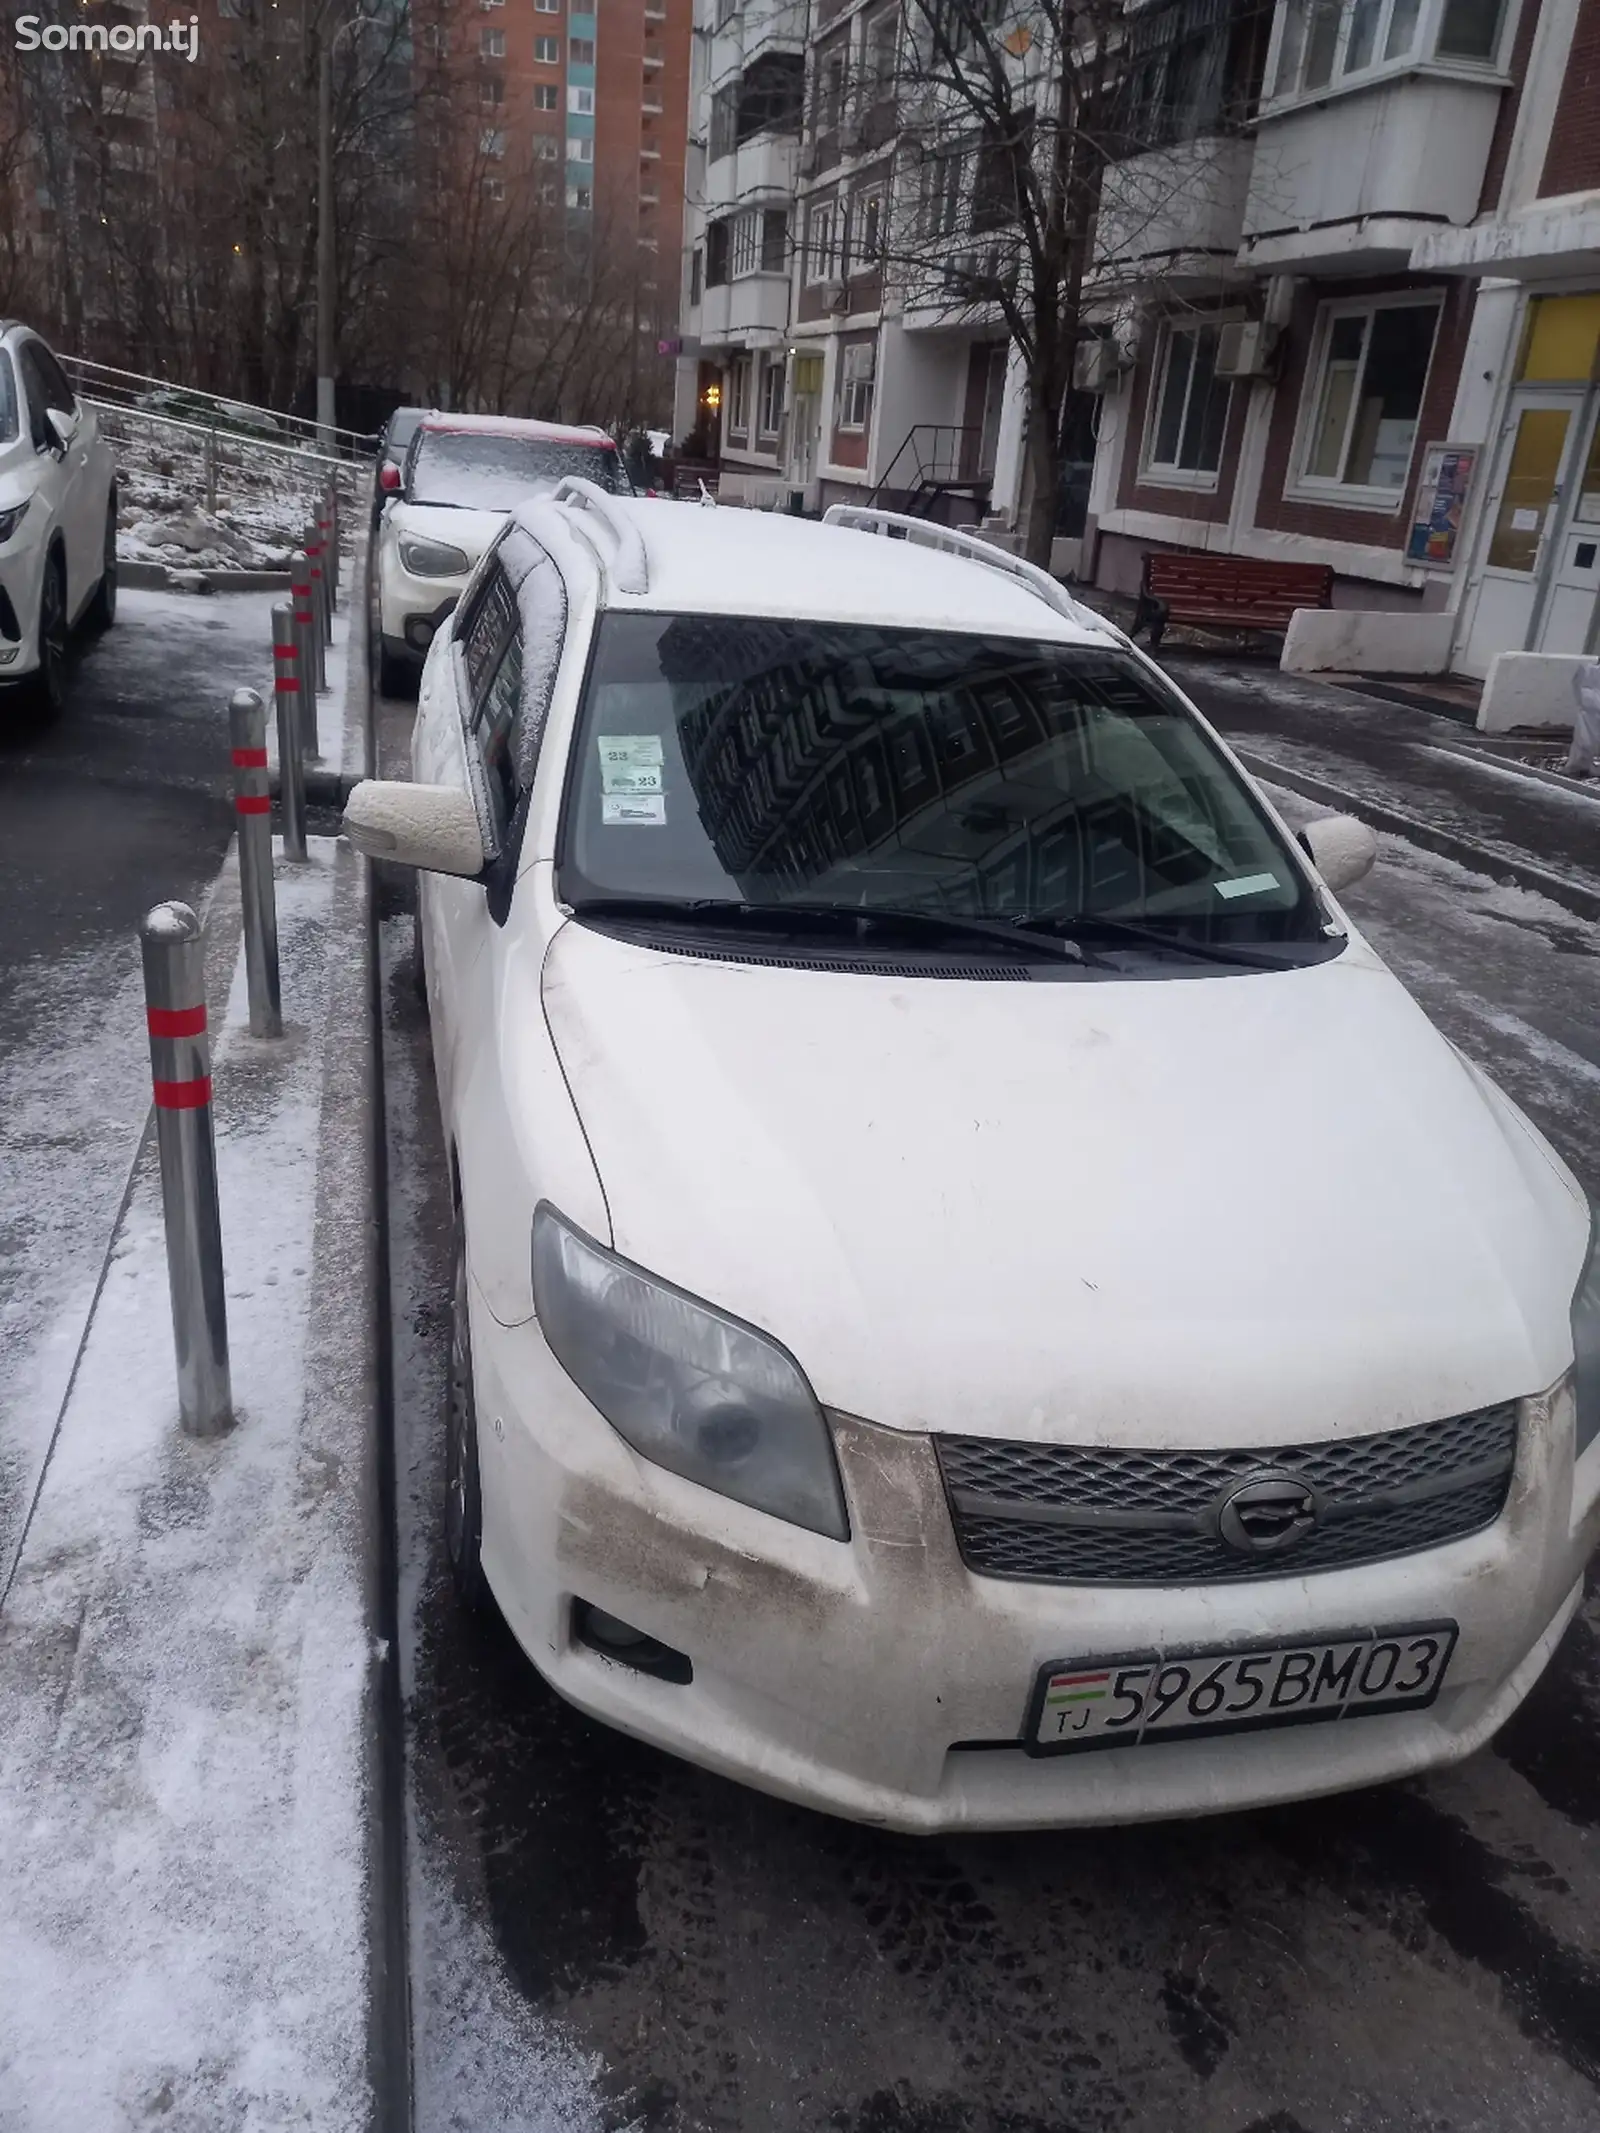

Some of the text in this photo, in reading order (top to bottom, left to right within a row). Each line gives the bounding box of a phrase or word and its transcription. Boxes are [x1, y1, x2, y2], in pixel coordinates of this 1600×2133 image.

[637, 775, 657, 787] 23
[1056, 1637, 1440, 1734] TJ 5965BM03
